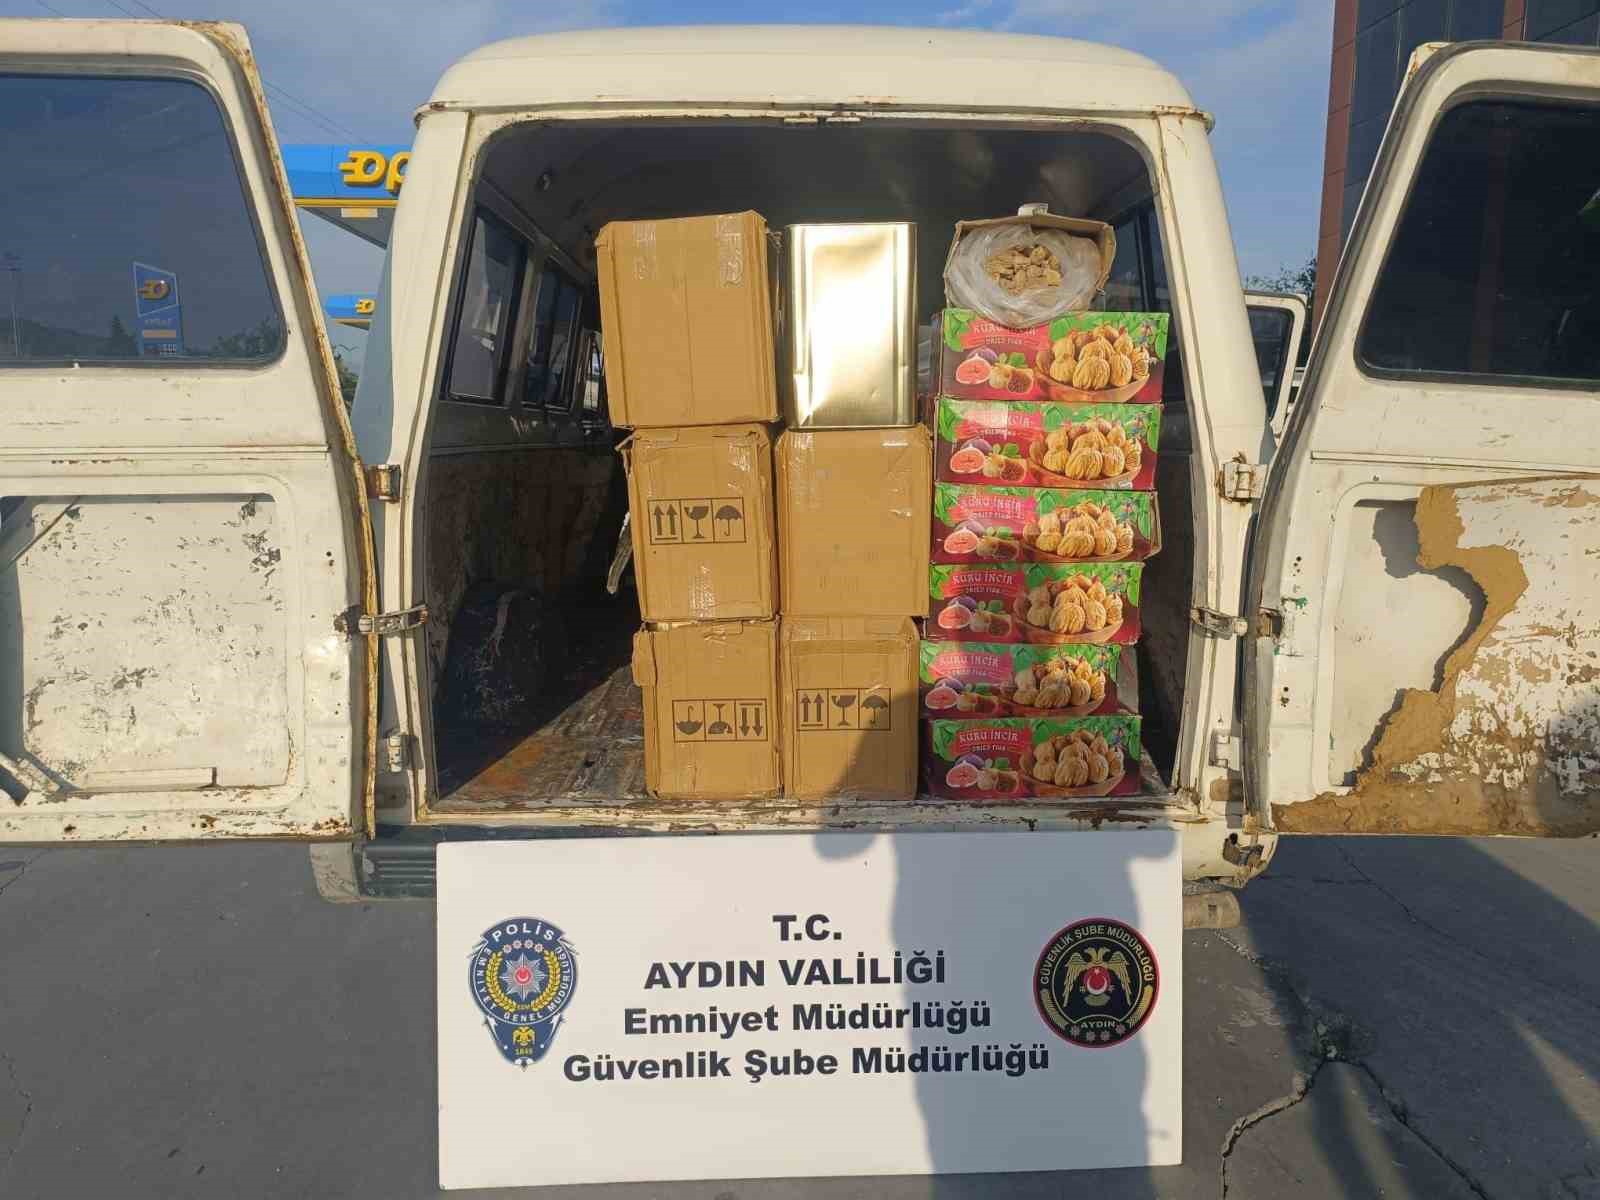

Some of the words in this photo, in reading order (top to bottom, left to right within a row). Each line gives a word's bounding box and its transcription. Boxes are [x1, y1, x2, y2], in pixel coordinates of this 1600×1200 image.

[492, 922, 554, 942] POLİS
[772, 914, 842, 941] T.C.
[644, 960, 765, 989] AYDIN
[778, 949, 945, 986] VALİLİĞİ
[624, 1006, 779, 1039] Emniyet
[793, 1000, 991, 1033] Müdürlüğü
[563, 1051, 731, 1082] Güvenlik
[745, 1049, 838, 1083] Şube
[852, 1043, 1049, 1078] Müdürlüğü
